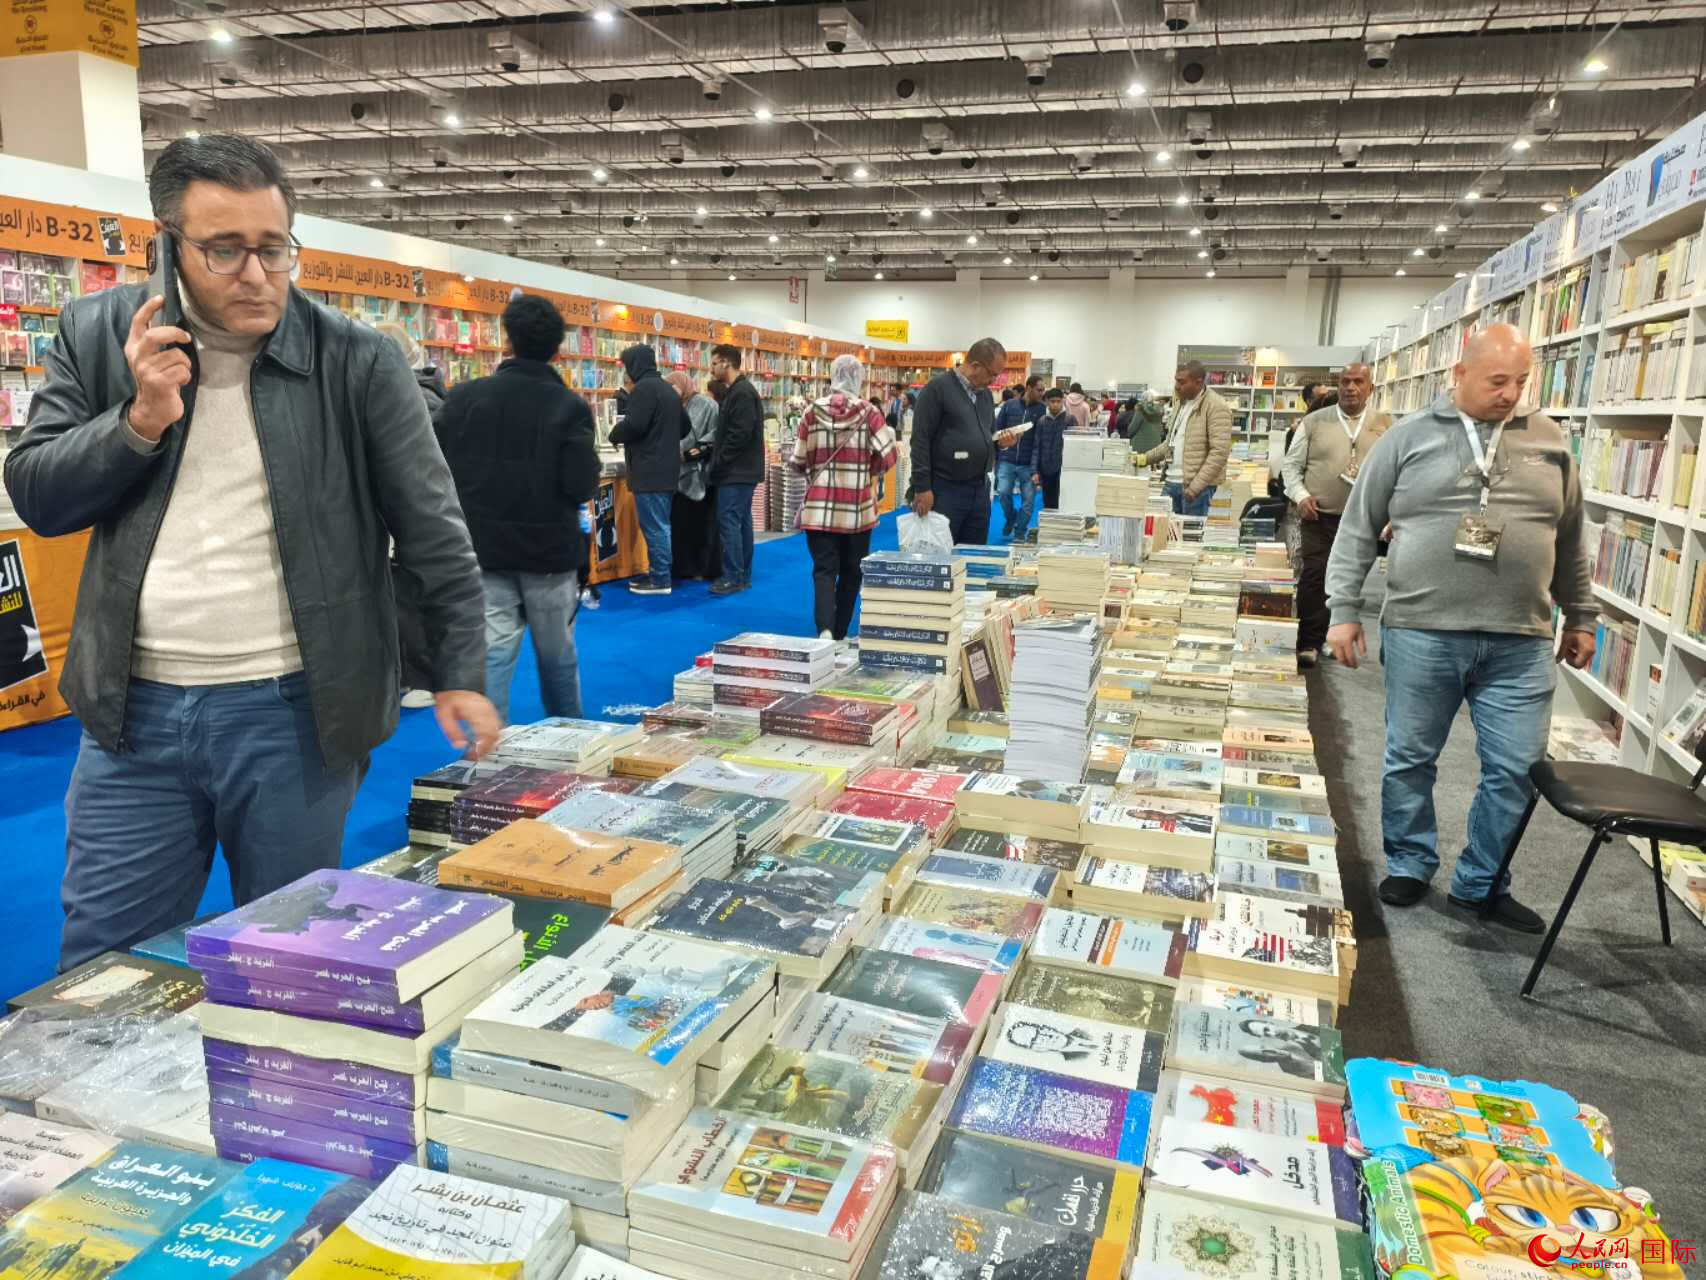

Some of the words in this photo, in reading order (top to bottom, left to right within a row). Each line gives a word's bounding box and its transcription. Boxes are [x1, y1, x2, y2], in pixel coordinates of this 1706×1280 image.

[26, 211, 42, 238] دار
[46, 215, 94, 242] B-32
[384, 272, 410, 289] B-32
[107, 1154, 182, 1179] العراق
[1282, 1155, 1305, 1190] مدخل
[91, 1170, 137, 1190] العربية
[1383, 1159, 1407, 1204] Animals
[136, 1184, 192, 1206] والجزيرة
[411, 1182, 450, 1200] بشر
[451, 1191, 472, 1204] بن
[221, 1201, 286, 1224] الفكر
[438, 1205, 473, 1220] وكتابه
[471, 1198, 527, 1215] عثمان
[178, 1218, 277, 1249] الخلدوني
[394, 1214, 426, 1233] تاريخ
[425, 1219, 446, 1234] في
[444, 1226, 478, 1242] المجد
[1394, 1203, 1425, 1266] Domestic
[162, 1241, 212, 1263] الميزان
[208, 1254, 243, 1268] في
